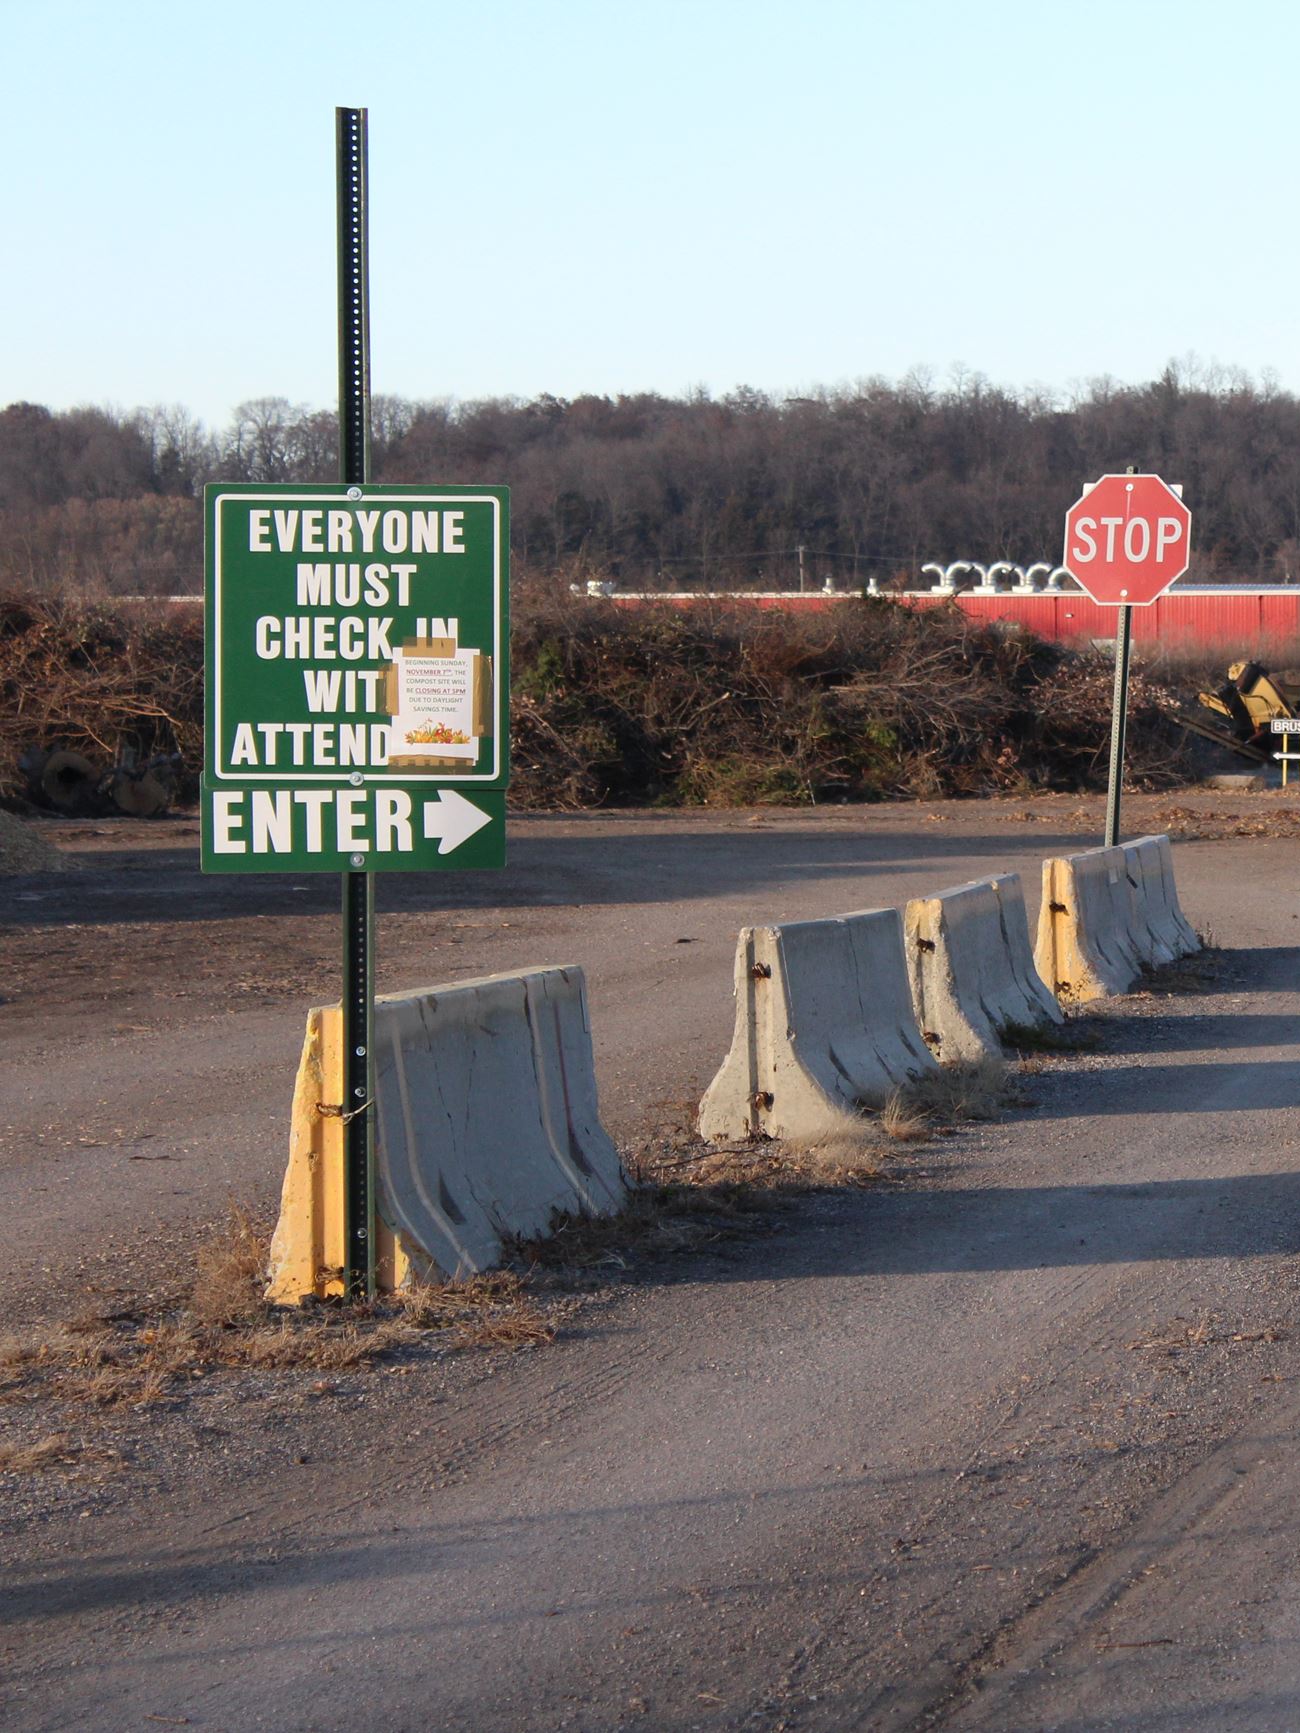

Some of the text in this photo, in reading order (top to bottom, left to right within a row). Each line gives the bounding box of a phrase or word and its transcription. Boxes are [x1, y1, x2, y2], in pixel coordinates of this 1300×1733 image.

[249, 510, 465, 554] EVERYONE
[1073, 516, 1183, 563] STOP
[296, 563, 417, 607] MUST
[256, 615, 459, 660] CHECK IN
[440, 659, 469, 668] SUNDAY,
[303, 670, 384, 713] WIT
[230, 722, 393, 766] ATTEND
[212, 789, 413, 854] ENTER
